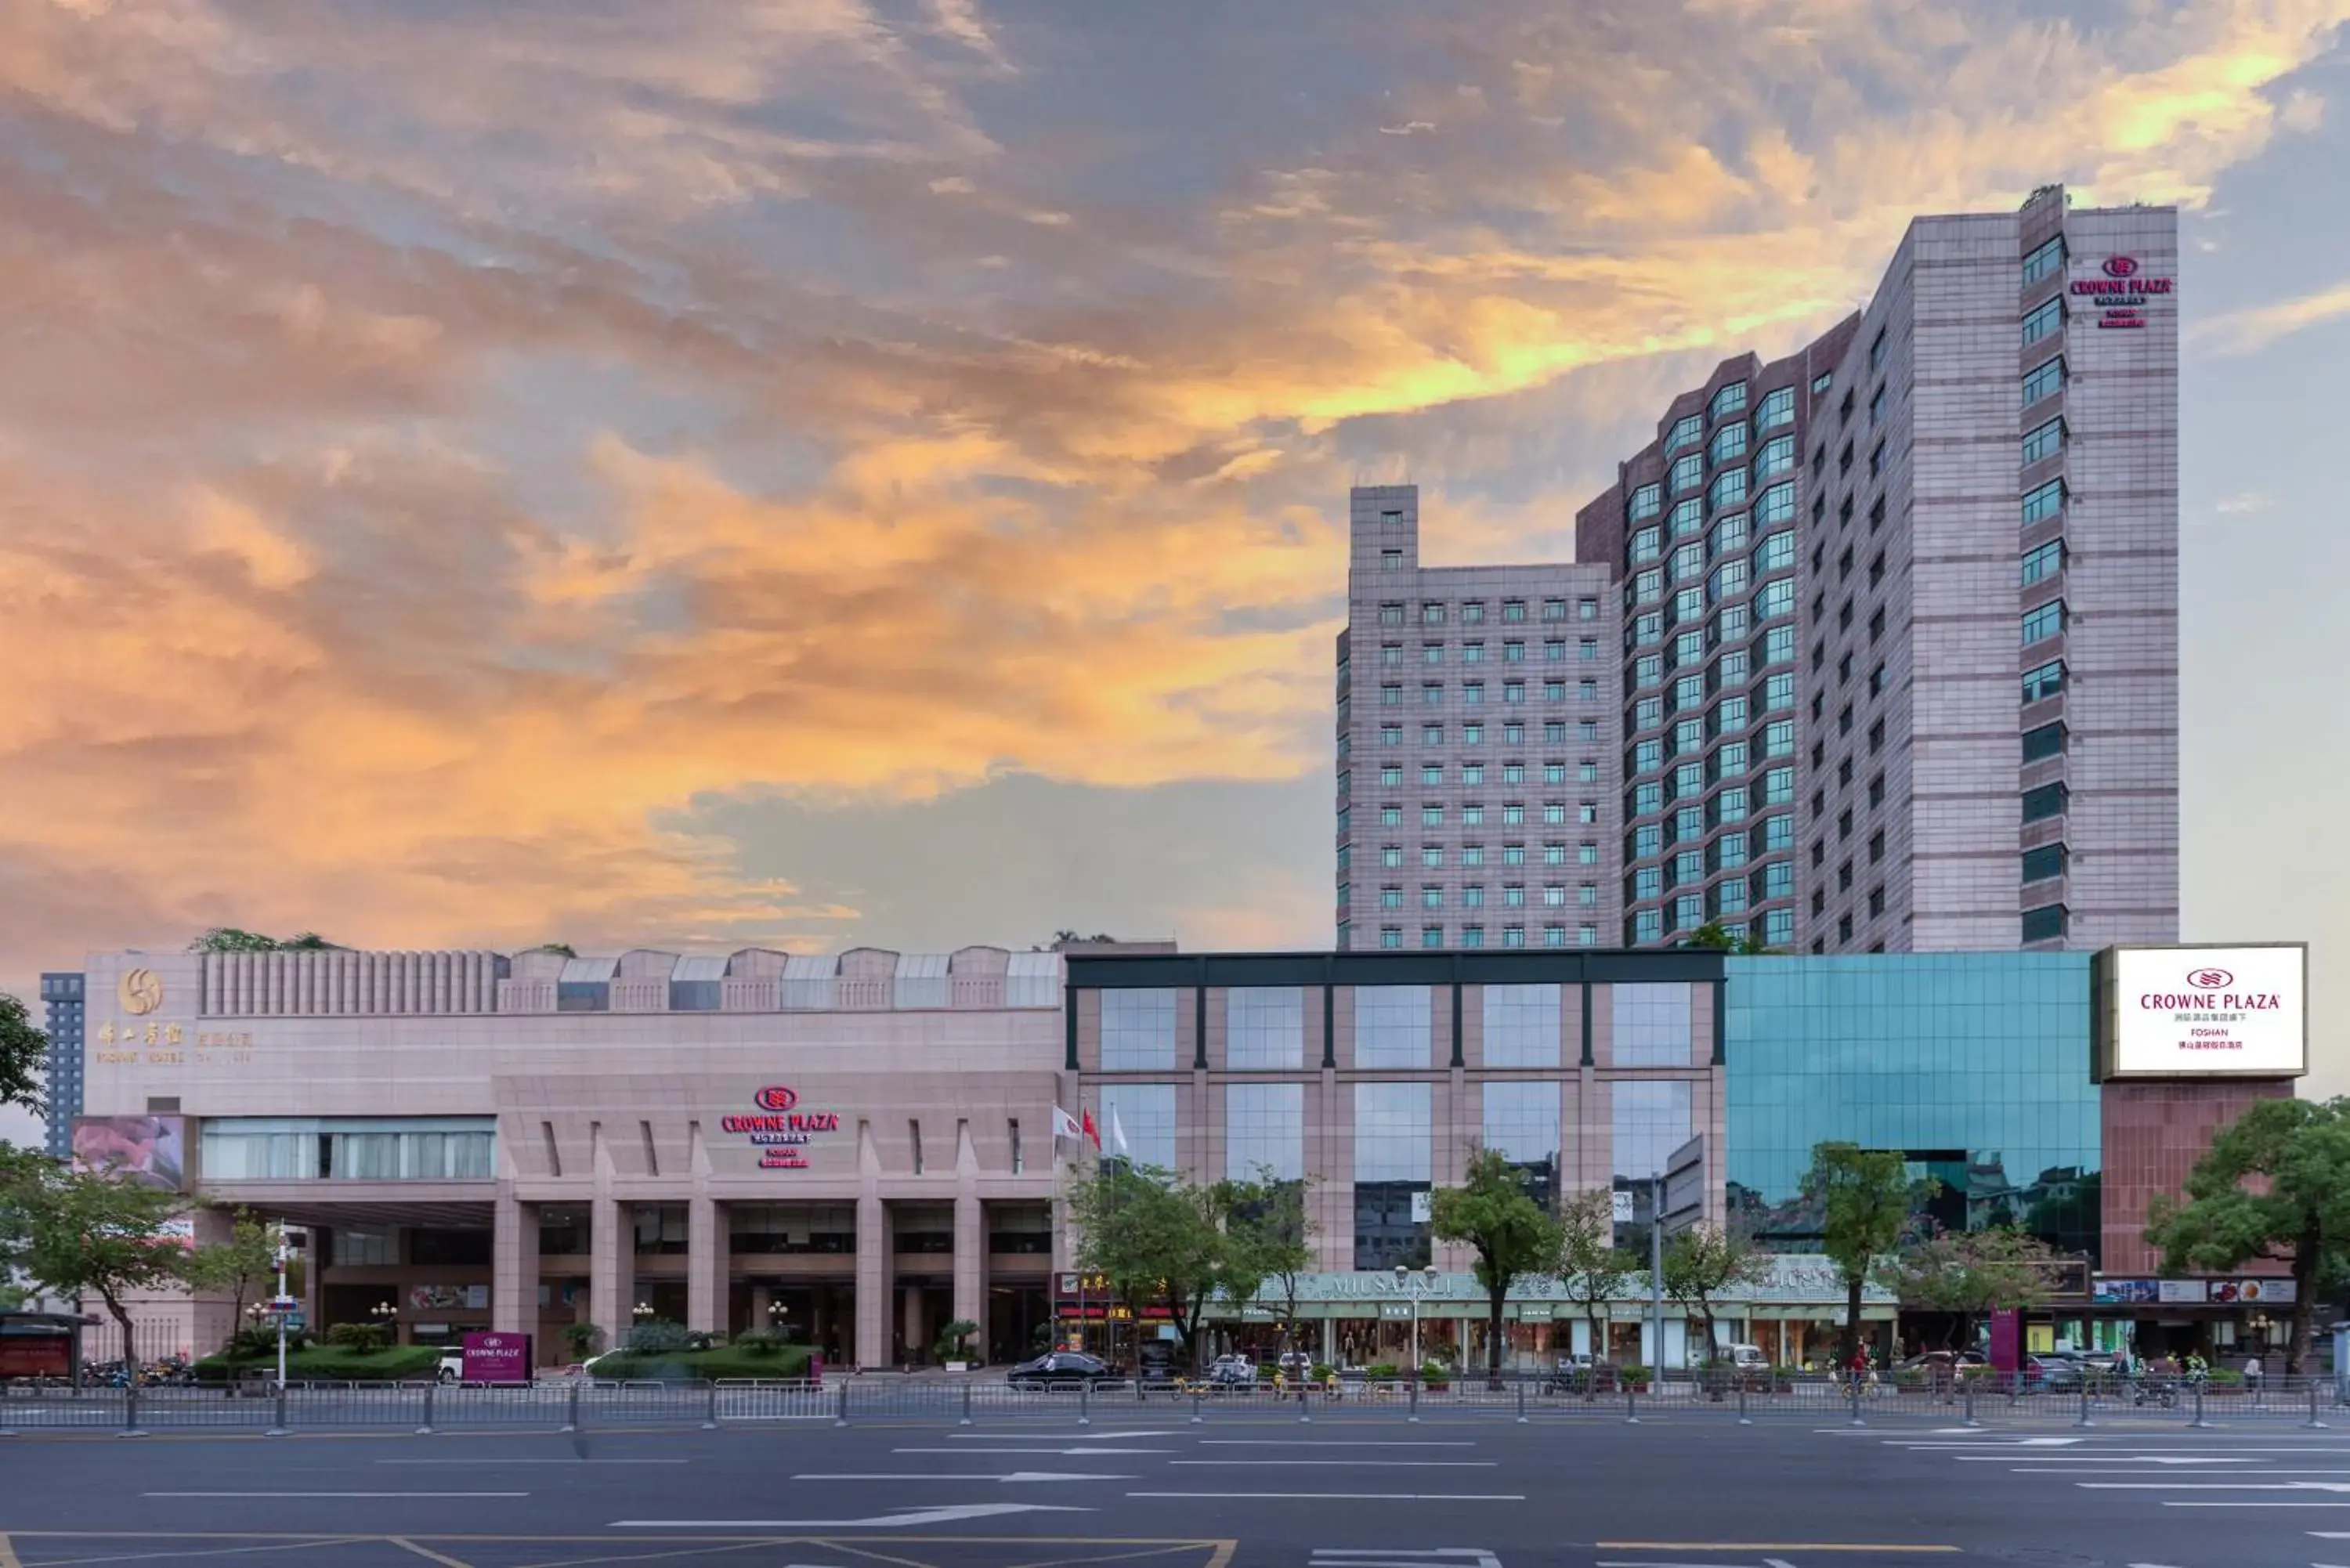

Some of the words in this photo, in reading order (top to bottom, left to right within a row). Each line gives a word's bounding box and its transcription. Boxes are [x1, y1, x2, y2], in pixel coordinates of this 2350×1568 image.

[2070, 280, 2126, 295] CROWNE
[2128, 277, 2172, 294] PLAZA
[2141, 994, 2216, 1010] CROWNE
[2224, 994, 2280, 1010] PLAZA
[2191, 1028, 2229, 1037] FOSHAN
[722, 1115, 786, 1133] CROWNE
[788, 1113, 839, 1131] PLAZA
